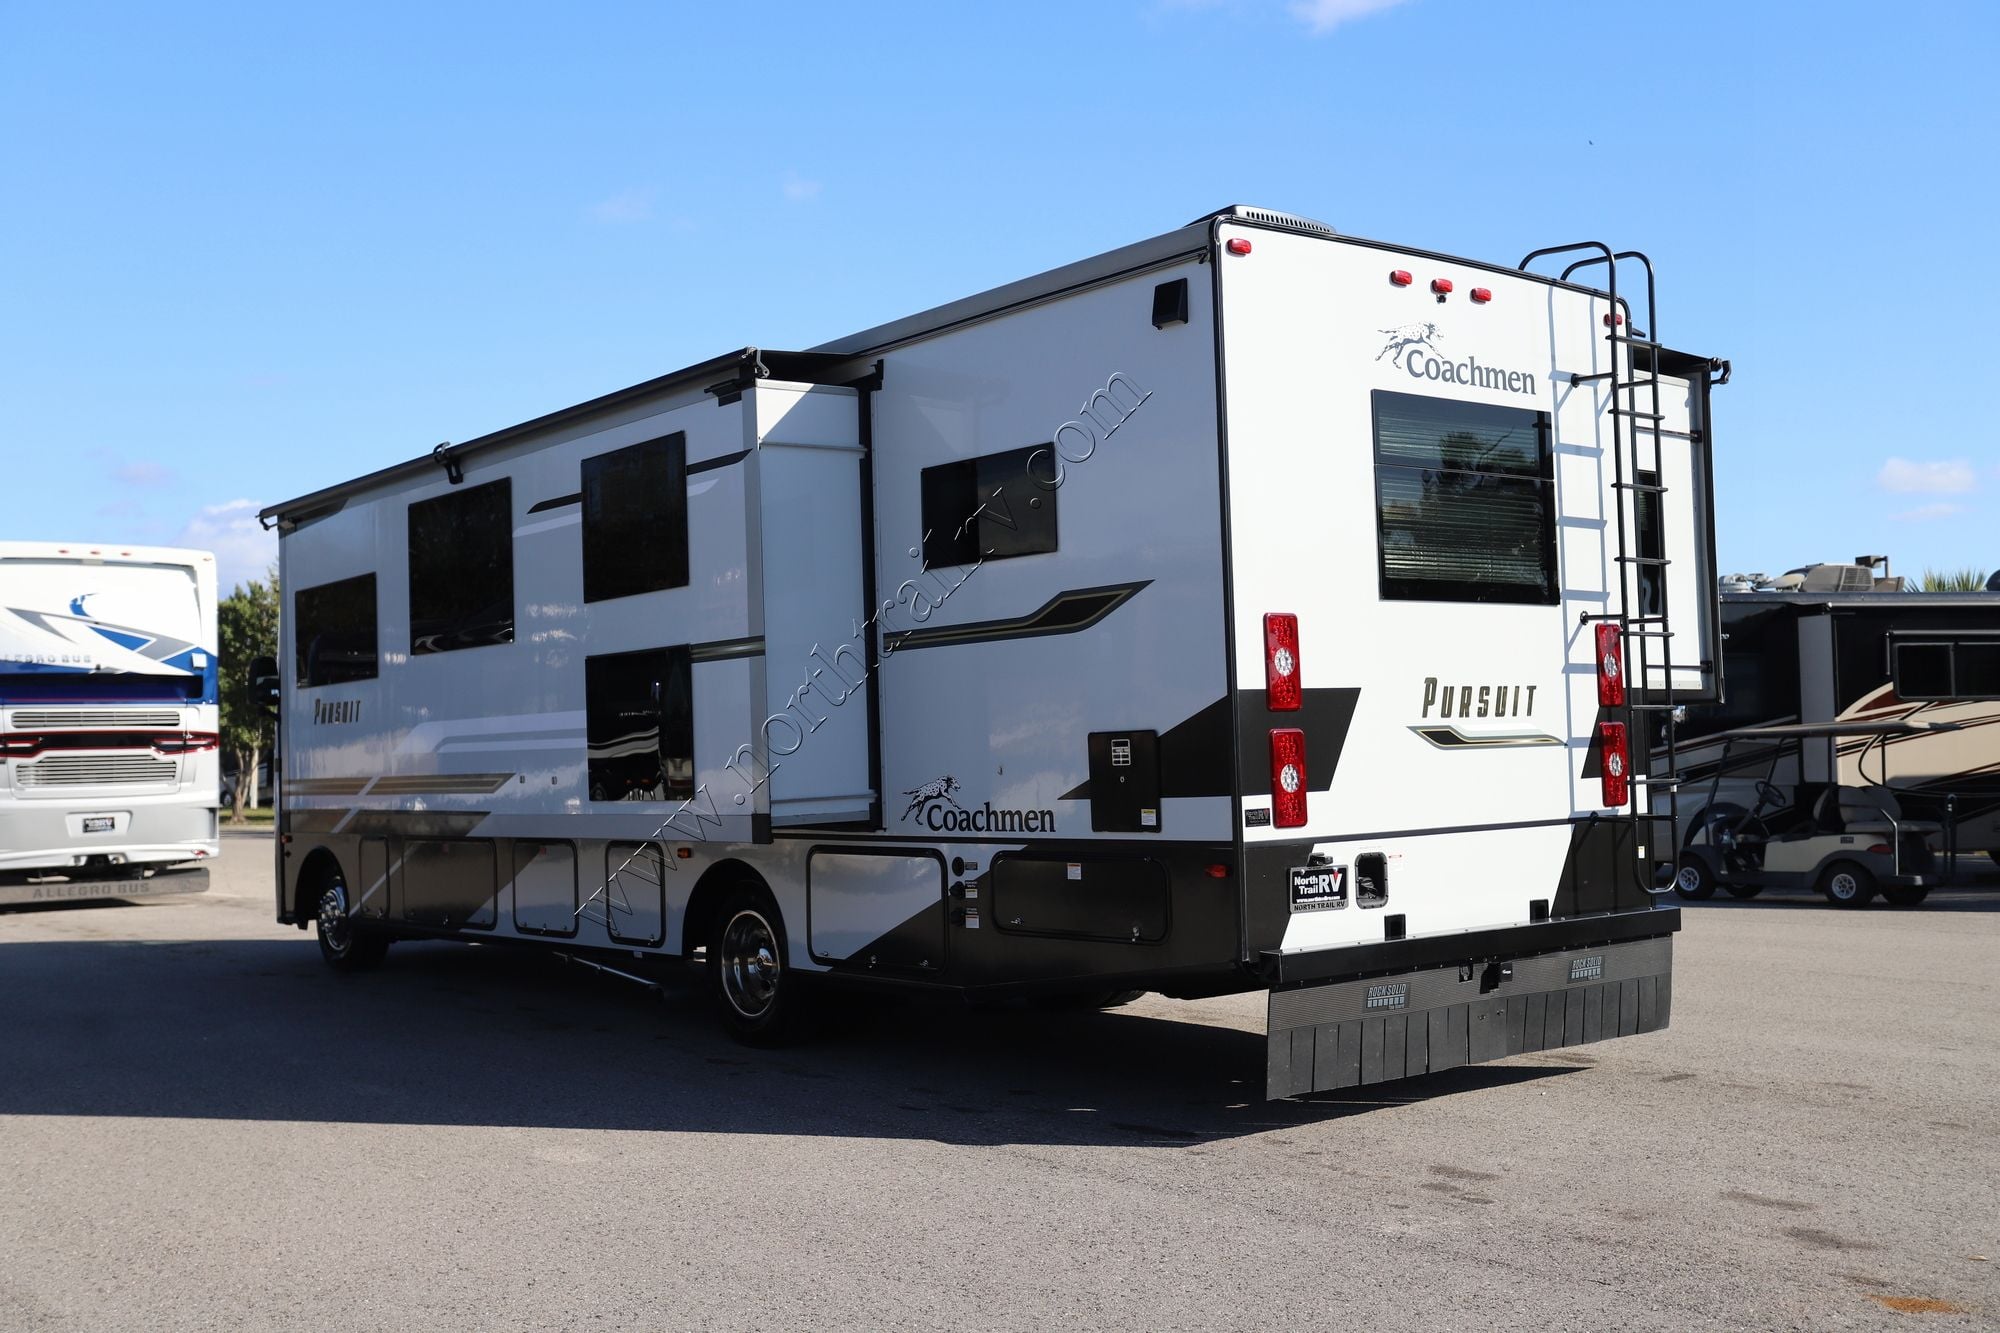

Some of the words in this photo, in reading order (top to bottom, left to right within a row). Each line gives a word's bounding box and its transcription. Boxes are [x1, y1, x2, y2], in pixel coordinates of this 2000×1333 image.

[1406, 349, 1537, 395] Coachmen
[1421, 677, 1537, 718] PURSUIT
[313, 698, 361, 726] PURSUIT
[927, 801, 1056, 832] Coachmen
[32, 884, 111, 899] ALLEGRO
[117, 882, 150, 894] BUS
[1294, 875, 1318, 886] North
[1298, 884, 1318, 895] Trail
[1318, 873, 1343, 893] RV
[1294, 903, 1316, 911] NORTH
[1318, 901, 1335, 910] TRAIL
[1336, 900, 1345, 908] RV
[1367, 985, 1387, 998] ROCK
[1387, 983, 1407, 996] SOLID
